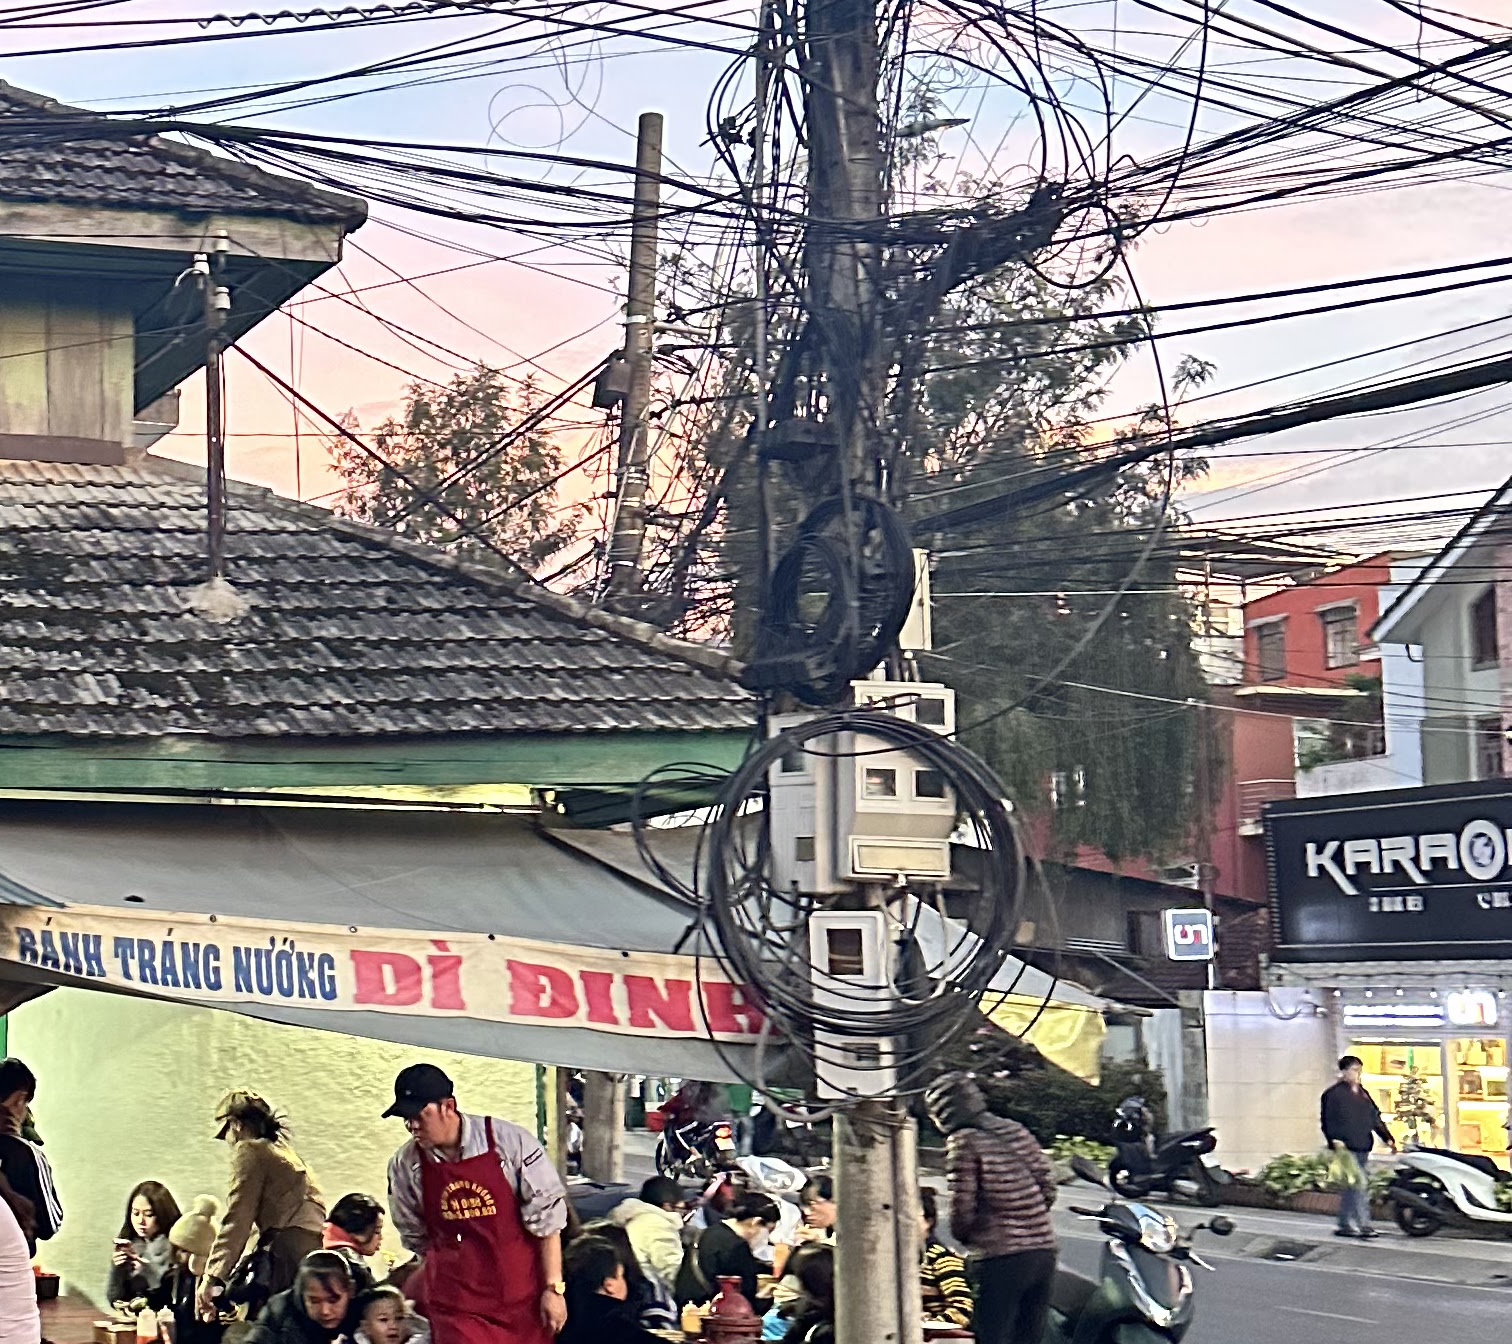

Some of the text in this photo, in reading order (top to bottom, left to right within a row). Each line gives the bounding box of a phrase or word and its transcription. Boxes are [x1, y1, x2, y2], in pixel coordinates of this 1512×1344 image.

[1305, 819, 1512, 896] KARAO
[15, 916, 107, 978] BÁNH
[114, 927, 223, 992] TRÁNG
[232, 935, 338, 1001] NƯỚNG
[350, 939, 466, 1011] DÌ
